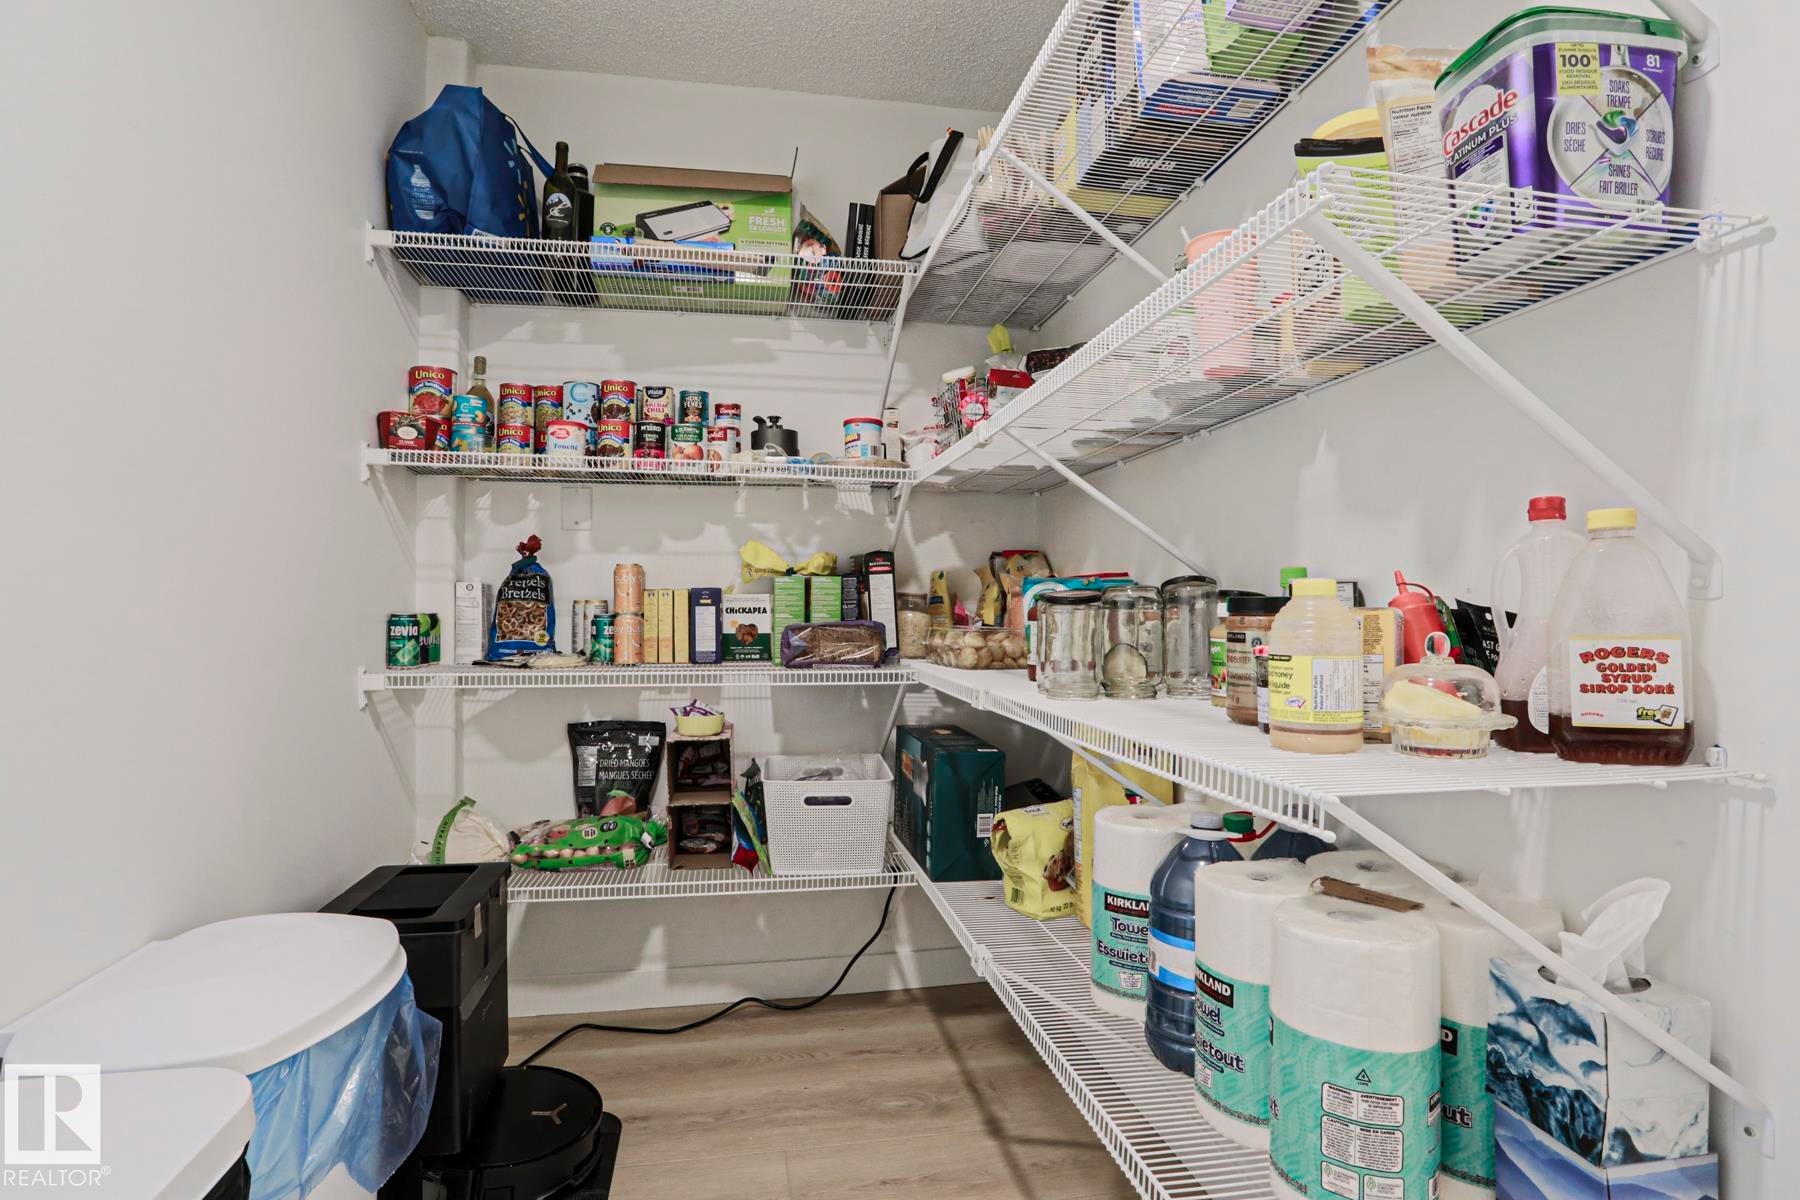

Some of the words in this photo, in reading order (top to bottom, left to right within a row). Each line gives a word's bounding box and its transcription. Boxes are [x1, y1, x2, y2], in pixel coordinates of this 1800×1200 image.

[1646, 54, 1661, 68] 81
[1609, 80, 1630, 94] SOAKS
[1606, 94, 1632, 109] TREMPE
[1442, 88, 1519, 157] Cascade
[1565, 121, 1586, 136] DRIES
[1445, 131, 1487, 167] PLATINUM
[1489, 113, 1518, 136] PLUS
[1645, 128, 1666, 145] SCRUBS
[1608, 164, 1632, 179] SHINES
[1599, 180, 1614, 195] FAIT
[1614, 181, 1639, 196] BRILLER
[748, 215, 785, 227] FRESH
[415, 370, 445, 379] Unico
[501, 387, 526, 396] Unico
[498, 428, 524, 436] Unico
[598, 424, 622, 432] Unico
[509, 575, 546, 589] retzels
[501, 586, 546, 601] Bretzels
[390, 623, 418, 637] zevia
[1578, 646, 1670, 664] ROGERS
[1596, 662, 1657, 673] GOLDEN
[1600, 673, 1653, 683] SYRUP
[1579, 683, 1629, 694] SIROP
[1632, 682, 1676, 695] DORÉ
[1637, 706, 1661, 717] free
[600, 759, 618, 768] DRIED
[620, 759, 650, 768] MANGOES
[599, 770, 630, 780] MANGUES
[630, 769, 655, 780] SÉCHÉE
[1107, 894, 1149, 911] KIRKLA
[1110, 916, 1149, 936] Towe
[1097, 938, 1149, 965] Essuiet
[1195, 970, 1231, 997] KLAND
[1195, 997, 1222, 1026] owel
